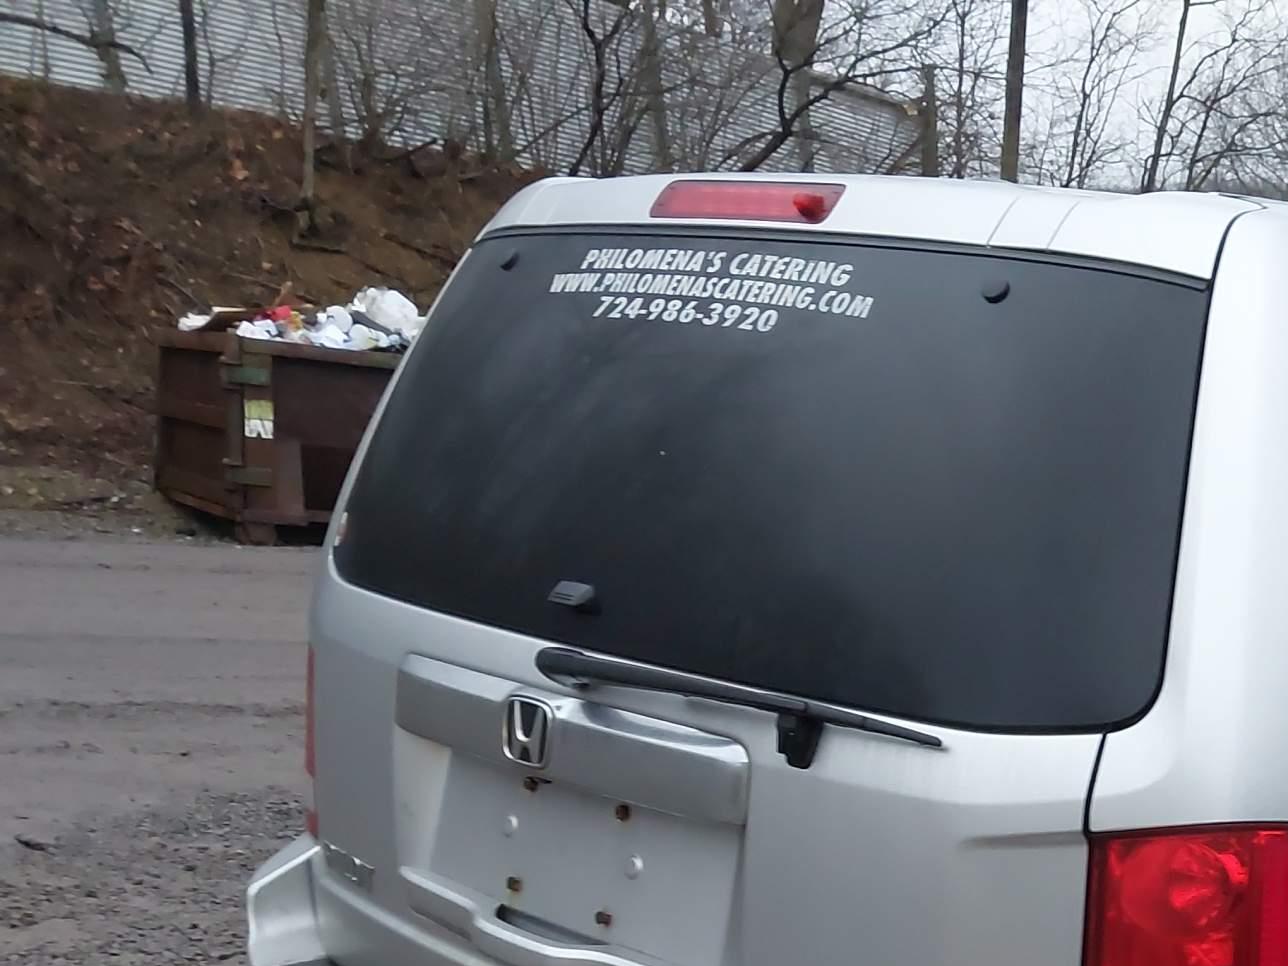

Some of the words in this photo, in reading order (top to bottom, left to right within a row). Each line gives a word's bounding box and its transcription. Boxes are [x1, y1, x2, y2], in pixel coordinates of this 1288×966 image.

[579, 248, 728, 274] PHILOMENA'S
[728, 253, 855, 287] CATERING
[548, 272, 876, 319] WWW.PHILOMENASCATERING.COM
[591, 295, 780, 333] 724-986-3920
